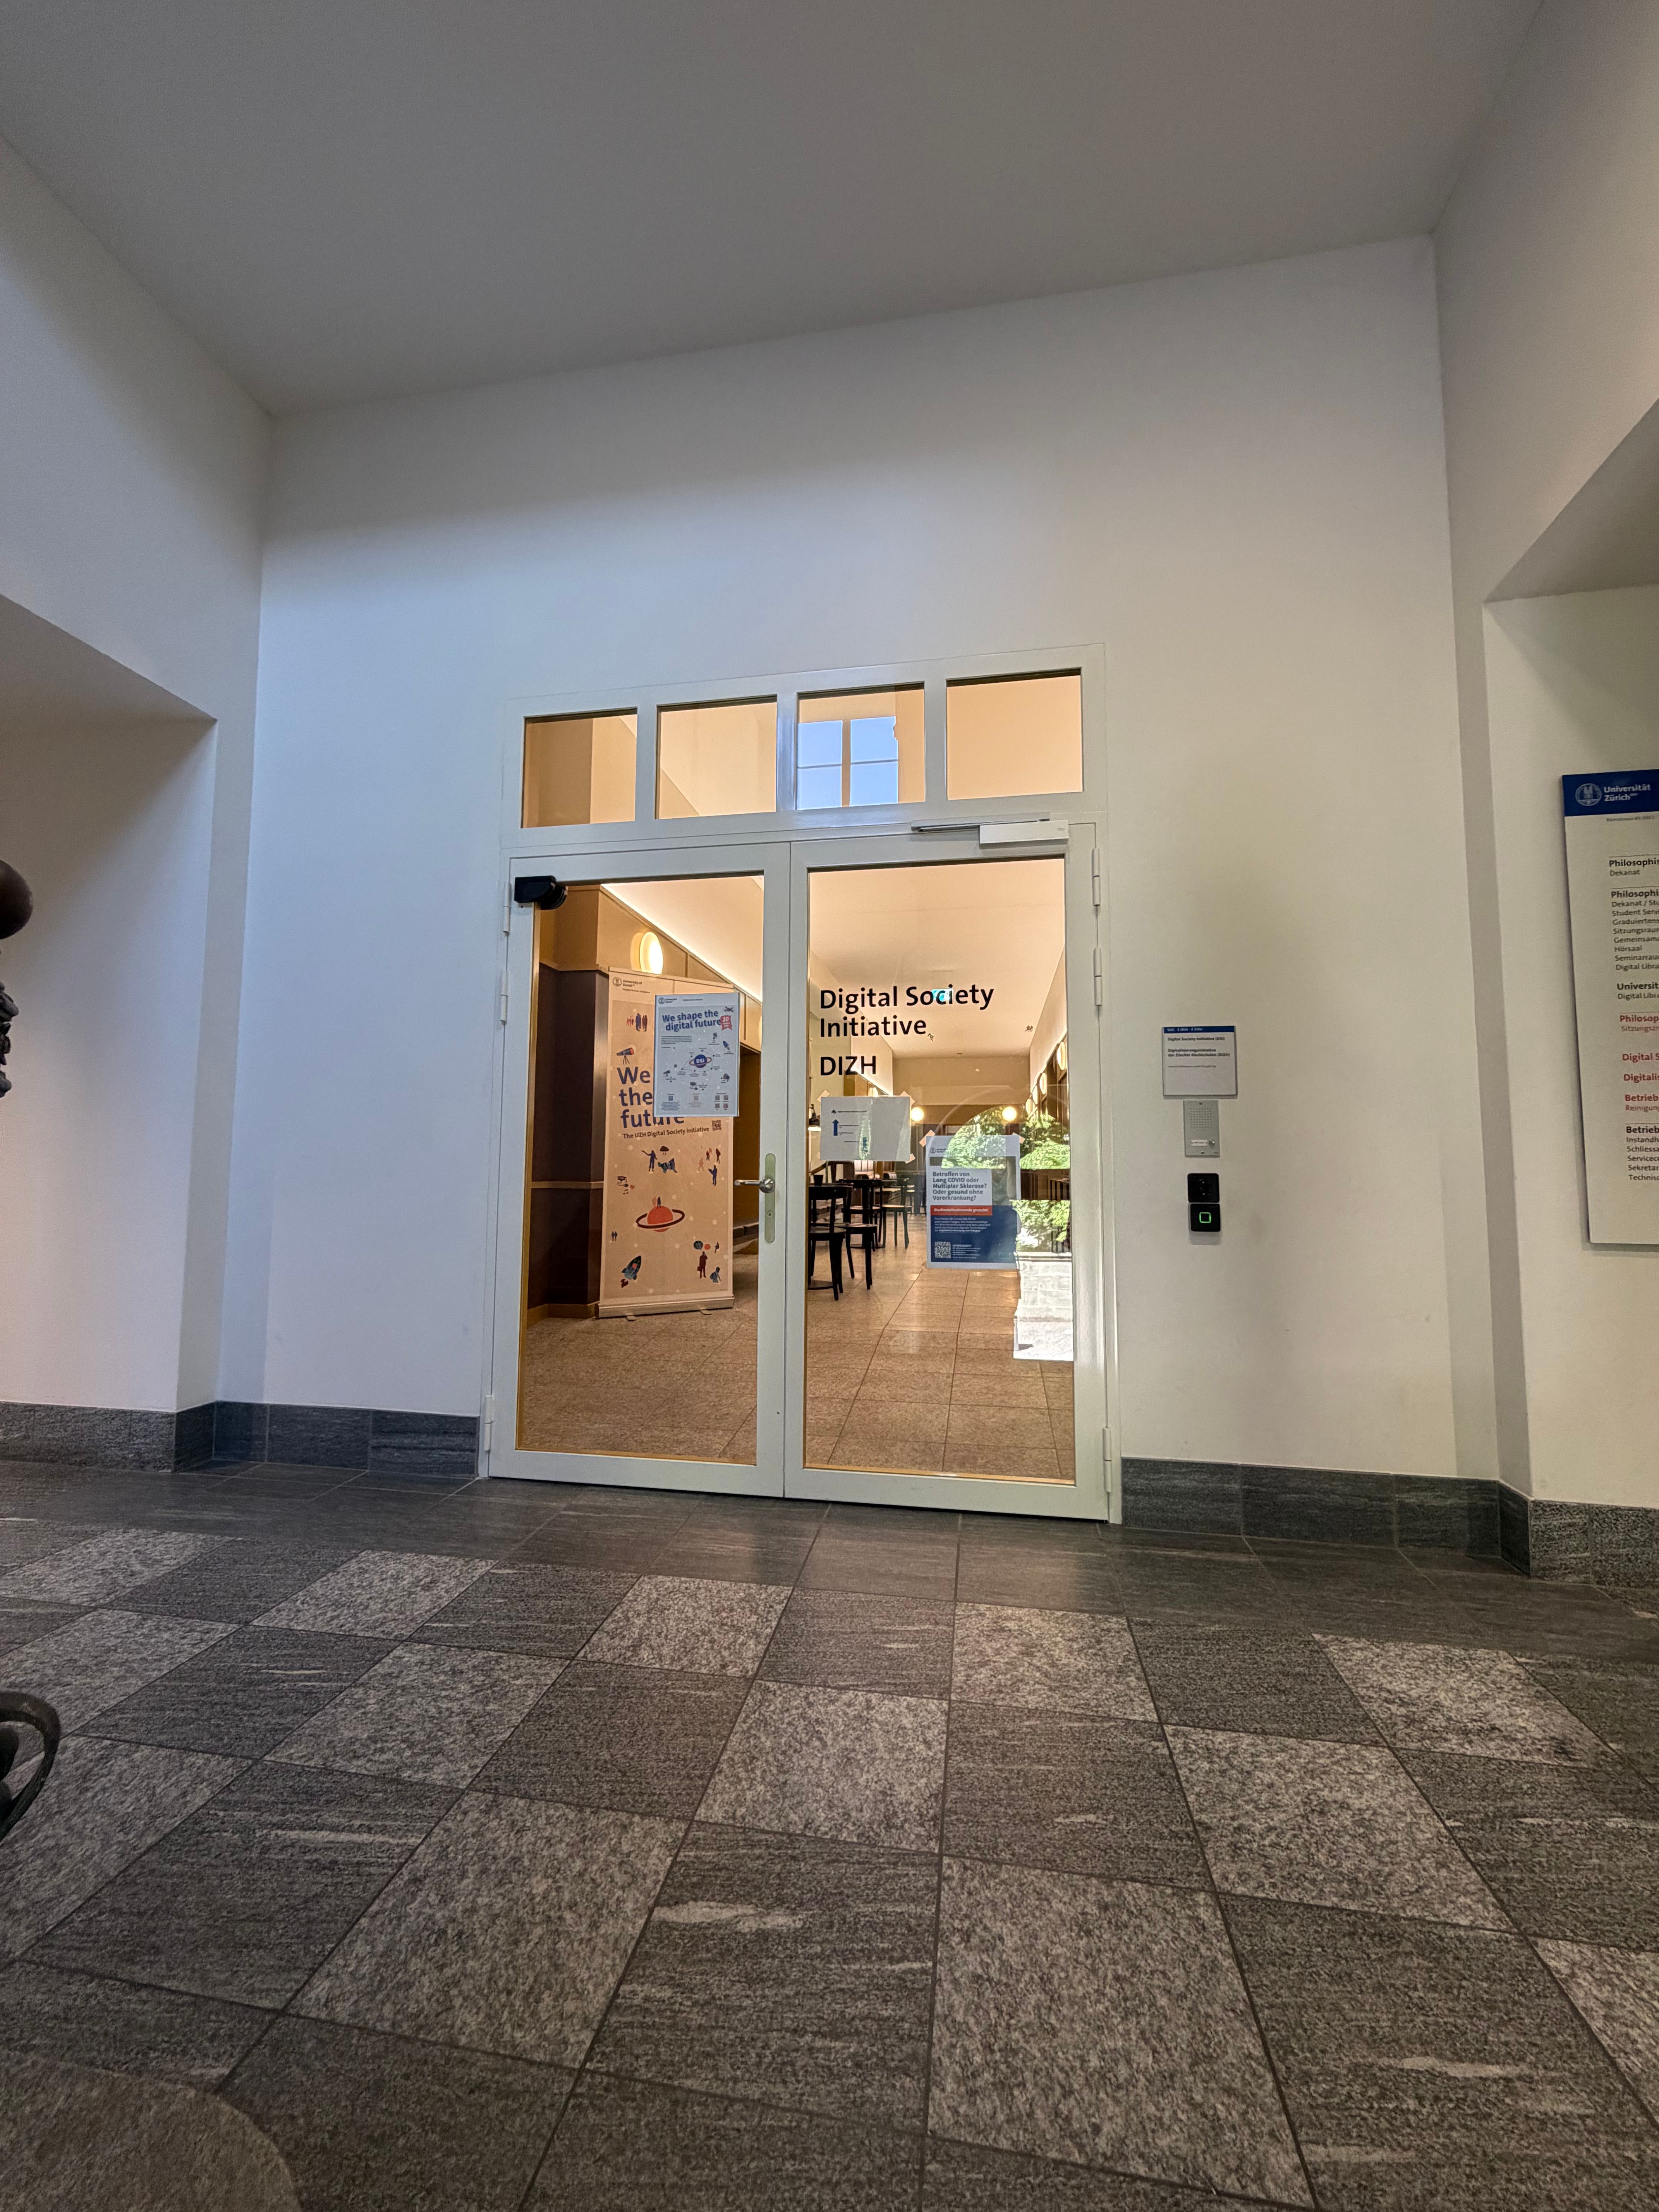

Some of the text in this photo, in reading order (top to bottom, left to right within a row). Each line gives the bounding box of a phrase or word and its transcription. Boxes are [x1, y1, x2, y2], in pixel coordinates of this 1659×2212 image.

[1604, 784, 1651, 793] Universität
[1611, 889, 1659, 898] Philosophi
[1616, 963, 1640, 972] Digital
[820, 984, 994, 1015] Digital Society
[662, 1009, 719, 1023] We shape the
[665, 1020, 693, 1032] digital
[694, 1019, 721, 1028] future
[820, 1015, 927, 1037] Initiative
[1622, 1053, 1653, 1063] Digital
[820, 1055, 876, 1076] DIZH
[617, 1066, 651, 1085] We
[618, 1087, 653, 1106] the
[647, 1130, 665, 1138] Digital
